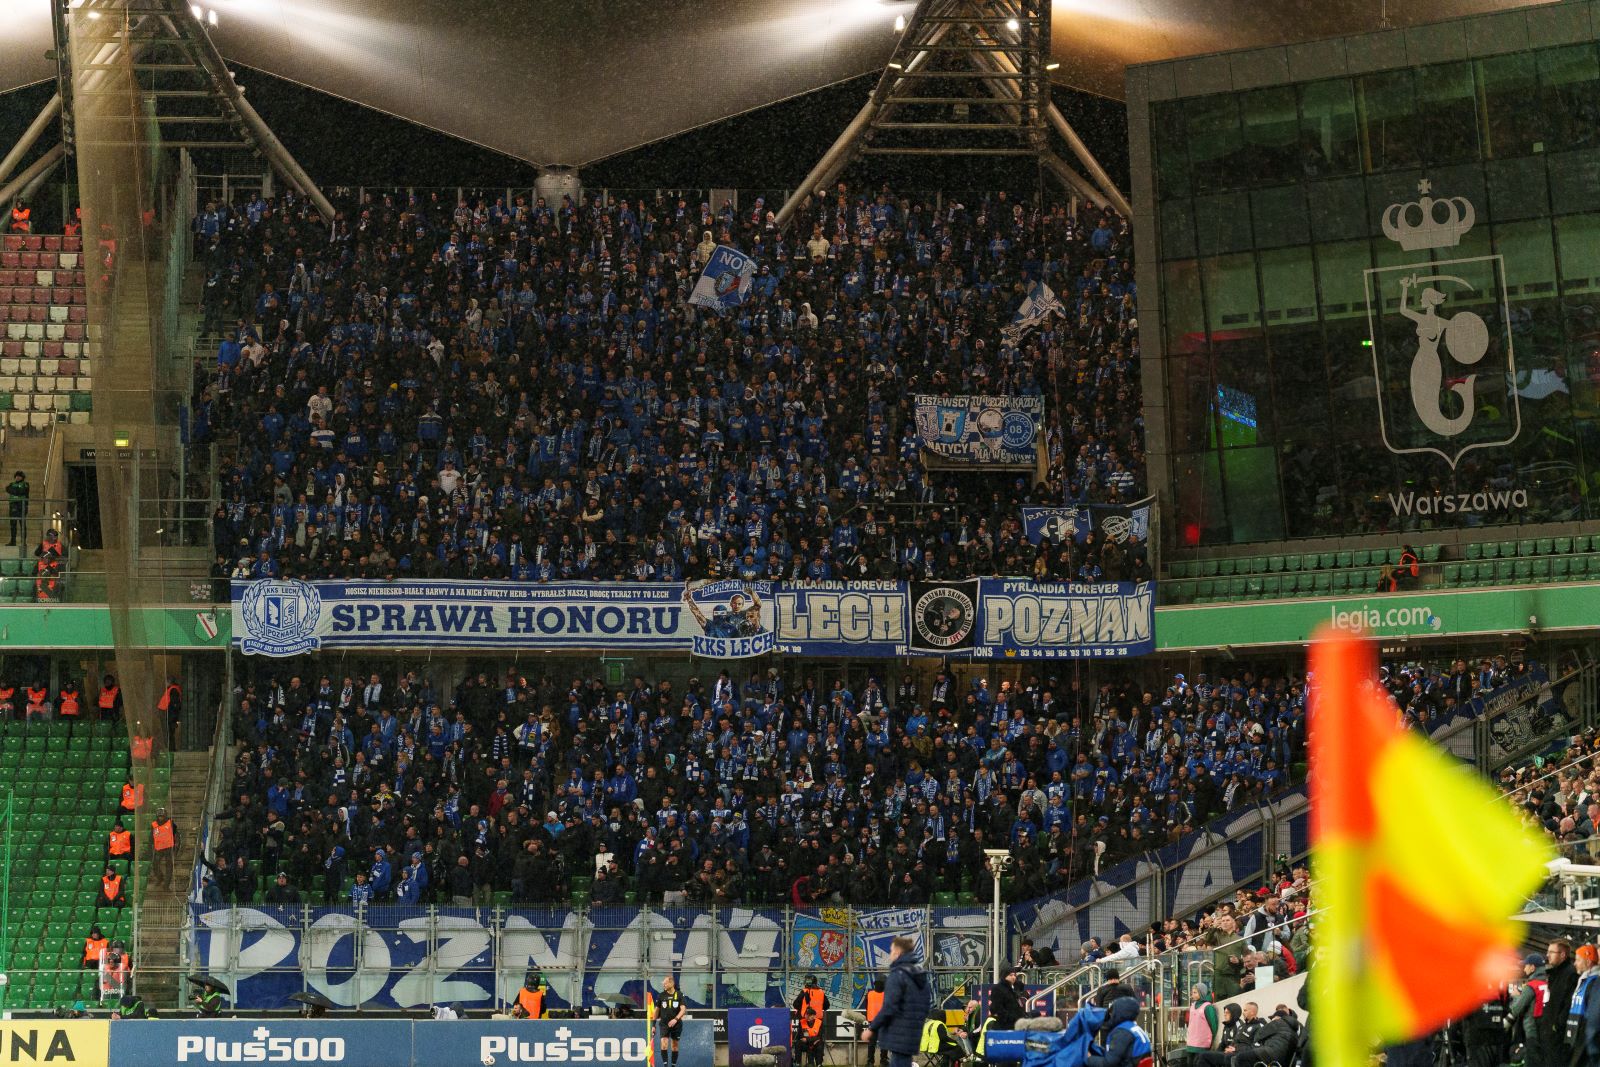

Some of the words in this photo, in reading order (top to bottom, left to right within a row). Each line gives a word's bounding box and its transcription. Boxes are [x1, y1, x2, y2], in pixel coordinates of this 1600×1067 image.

[1388, 489, 1528, 516] Warszawa
[345, 587, 368, 595] NOSISZ
[368, 587, 424, 596] NIEBIESKO-BIAŁE
[425, 588, 449, 596] BARWY
[450, 588, 455, 596] A
[455, 588, 465, 596] NA
[466, 588, 485, 597] NICH
[483, 587, 508, 598] ŚWIĘTY
[509, 590, 527, 598] HERB
[531, 588, 566, 598] WYBRAŁEŚ
[567, 589, 588, 599] NASZĄ
[589, 590, 610, 599] DROGĘ
[611, 590, 632, 599] TERAZ
[632, 590, 641, 599] TY
[643, 590, 651, 599] TO
[652, 590, 669, 599] LECH
[781, 580, 844, 590] PYRLANDIA
[847, 580, 898, 591] FOREVER
[1003, 582, 1065, 594] PYRLANDIA
[1069, 583, 1119, 594] FOREVER
[332, 604, 497, 633] SPRAWA
[508, 605, 681, 635] HONORU
[775, 592, 906, 644] LECH
[983, 580, 1152, 647] POZNAŃ
[1331, 604, 1431, 633] legia.com
[693, 635, 726, 656] KKS
[729, 631, 774, 656] LECH
[895, 645, 908, 656] WE
[866, 916, 890, 929] KKS
[897, 909, 923, 926] LECH
[0, 1030, 76, 1062] NA
[177, 1028, 345, 1063] Plus500
[481, 1027, 647, 1062] Plus500
